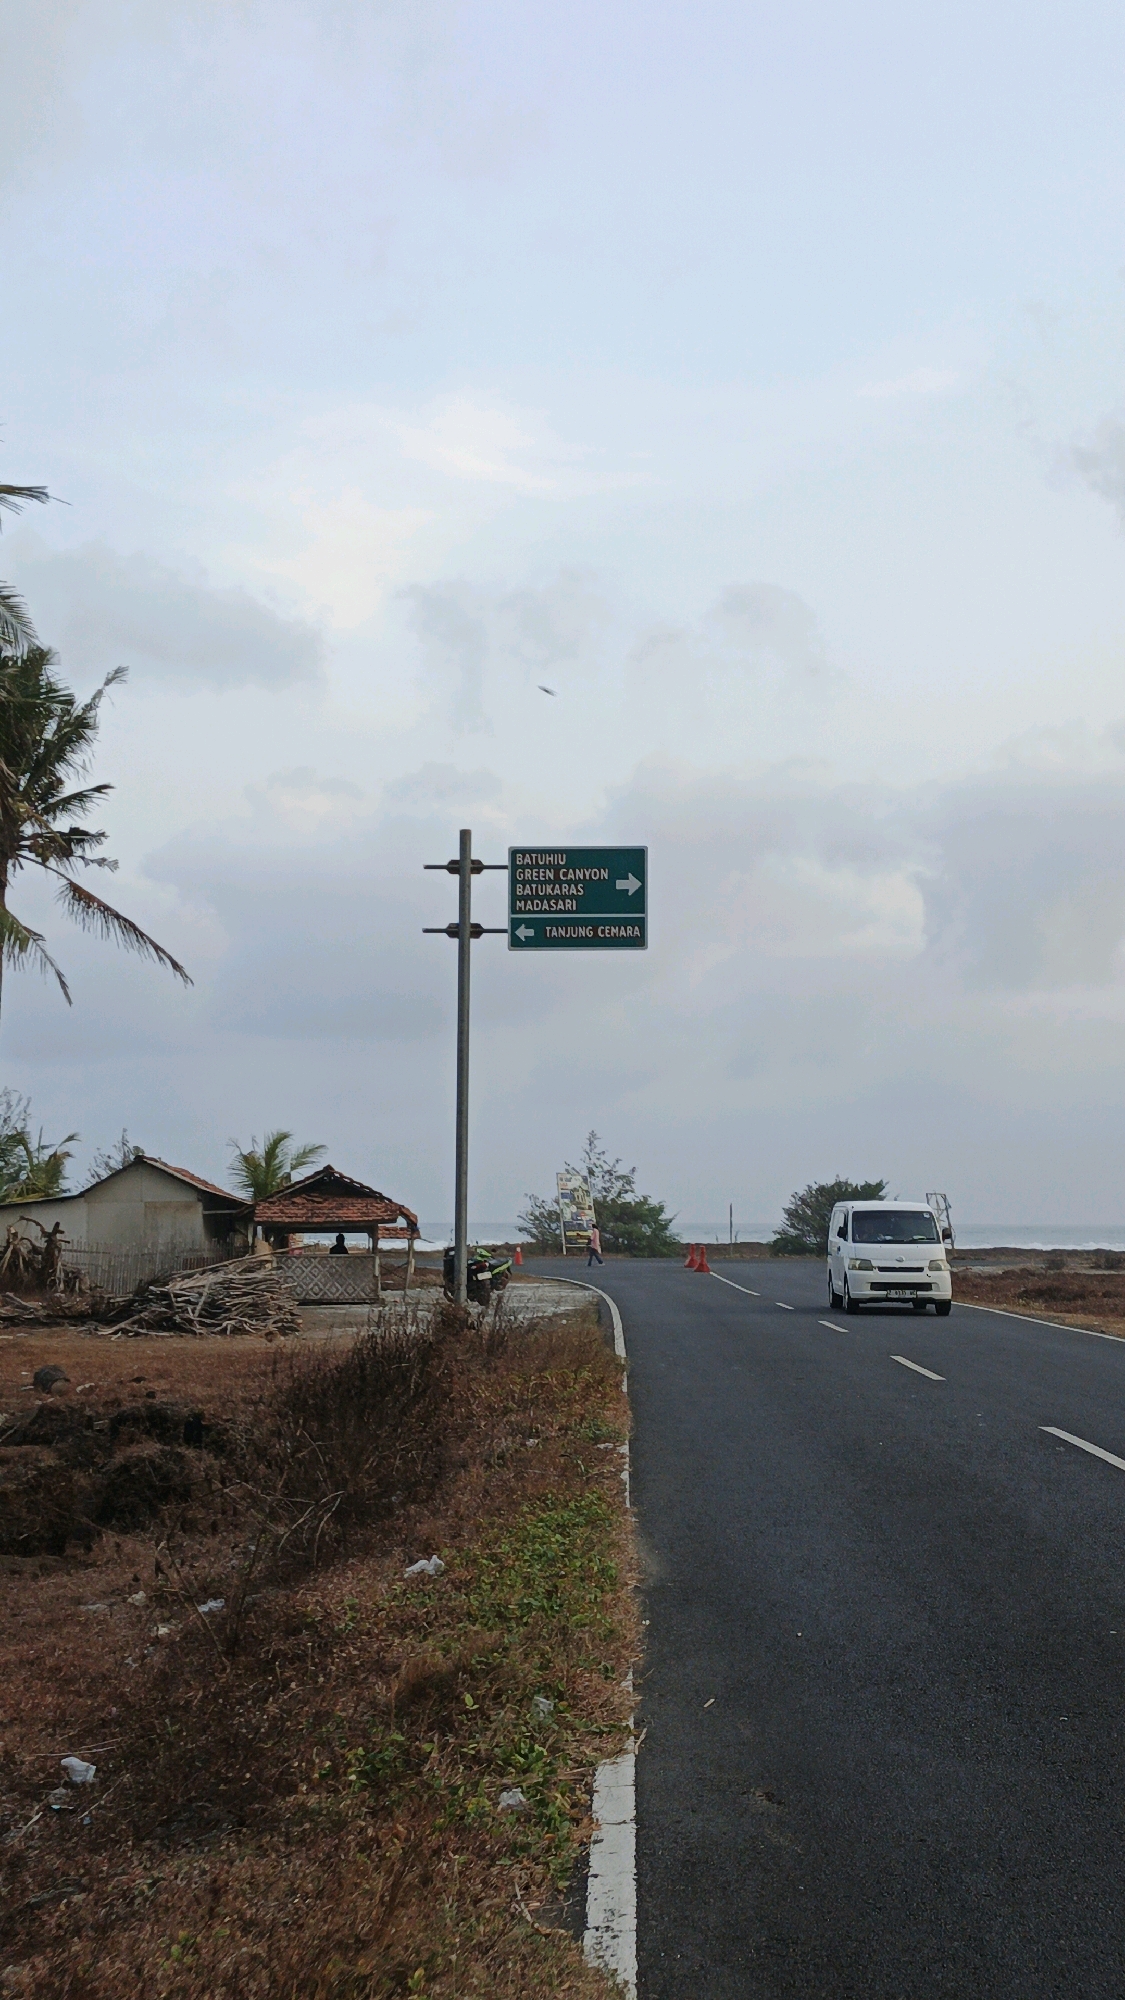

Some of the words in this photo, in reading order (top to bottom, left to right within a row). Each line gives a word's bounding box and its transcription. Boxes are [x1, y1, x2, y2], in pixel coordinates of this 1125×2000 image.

[516, 853, 566, 865] BATUHIU
[516, 868, 554, 880] GREEN
[560, 868, 608, 880] CANYON
[516, 883, 584, 896] BATUKARAS
[516, 899, 576, 911] MADASARI
[546, 926, 593, 938] TANJUNG
[598, 926, 640, 938] CEMARA
